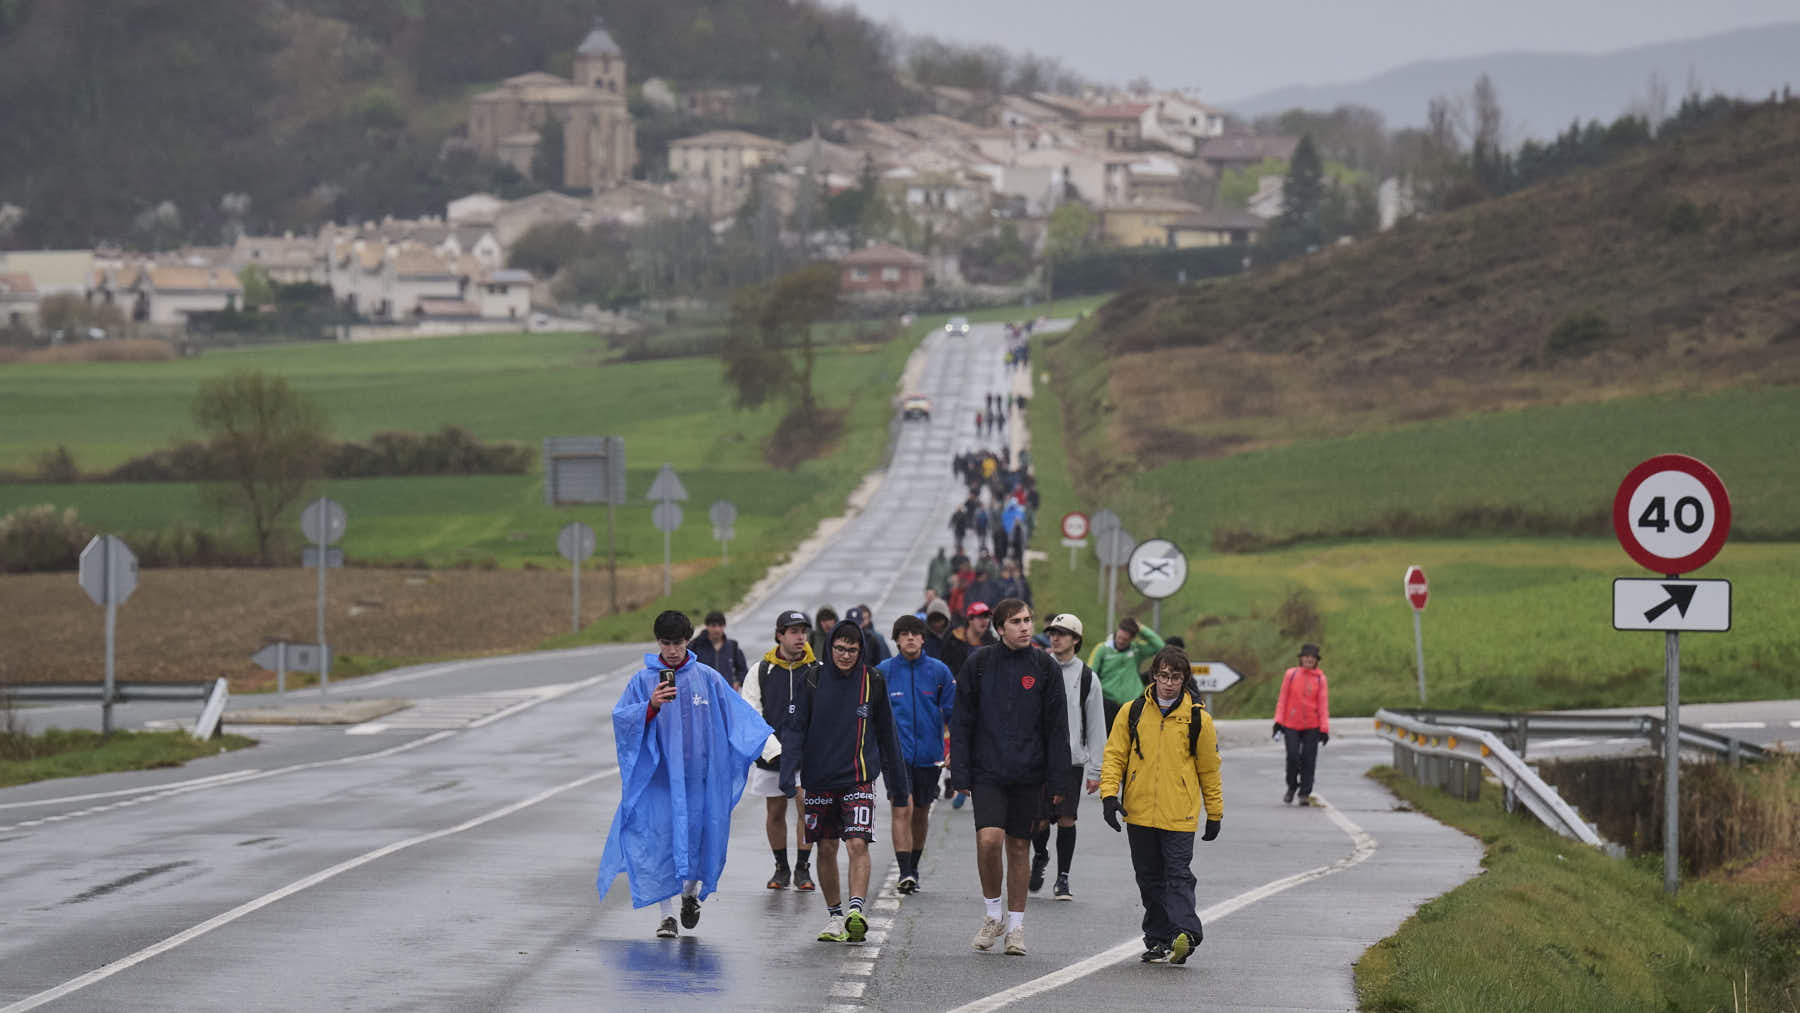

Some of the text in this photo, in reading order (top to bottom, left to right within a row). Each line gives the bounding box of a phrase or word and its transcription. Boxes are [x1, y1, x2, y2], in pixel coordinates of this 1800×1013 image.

[1638, 496, 1705, 533] 40
[843, 792, 873, 801] codere
[853, 806, 870, 825] 10
